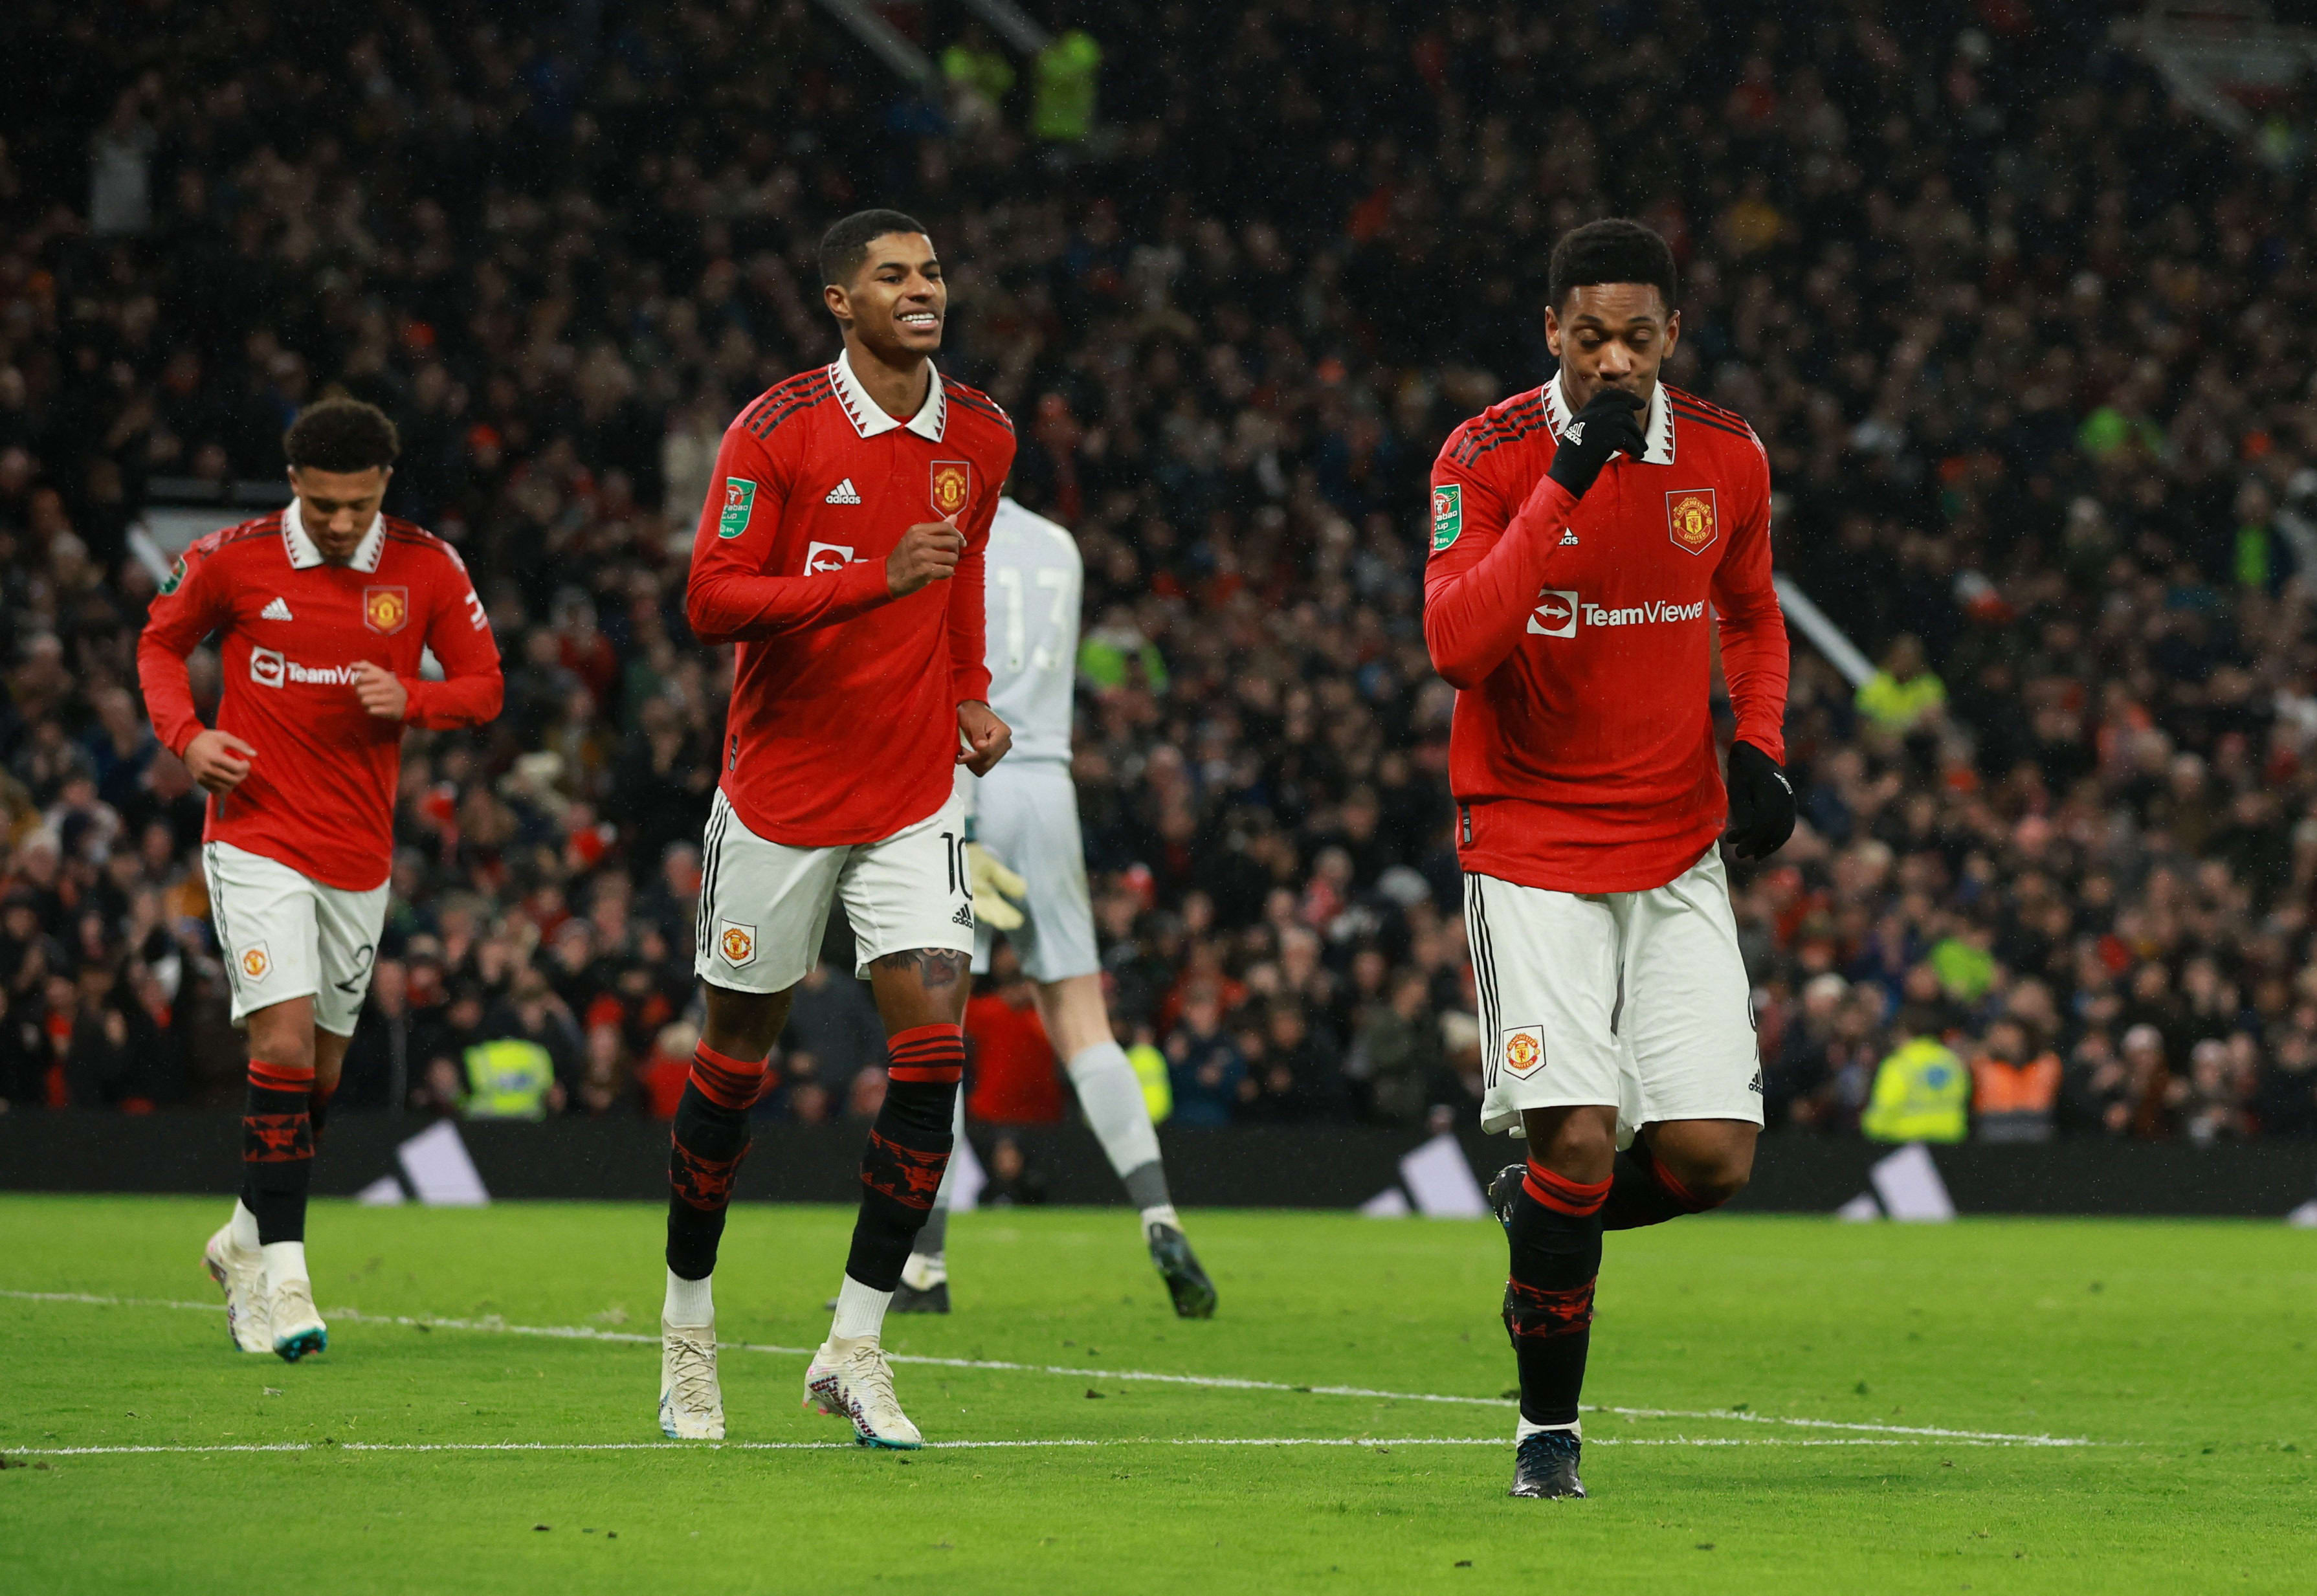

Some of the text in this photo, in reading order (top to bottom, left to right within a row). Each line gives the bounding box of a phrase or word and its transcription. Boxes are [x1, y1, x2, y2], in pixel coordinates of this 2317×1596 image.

[825, 494, 861, 504] adidas
[1684, 532, 1707, 540] UNITED
[286, 661, 360, 685] TeamVi
